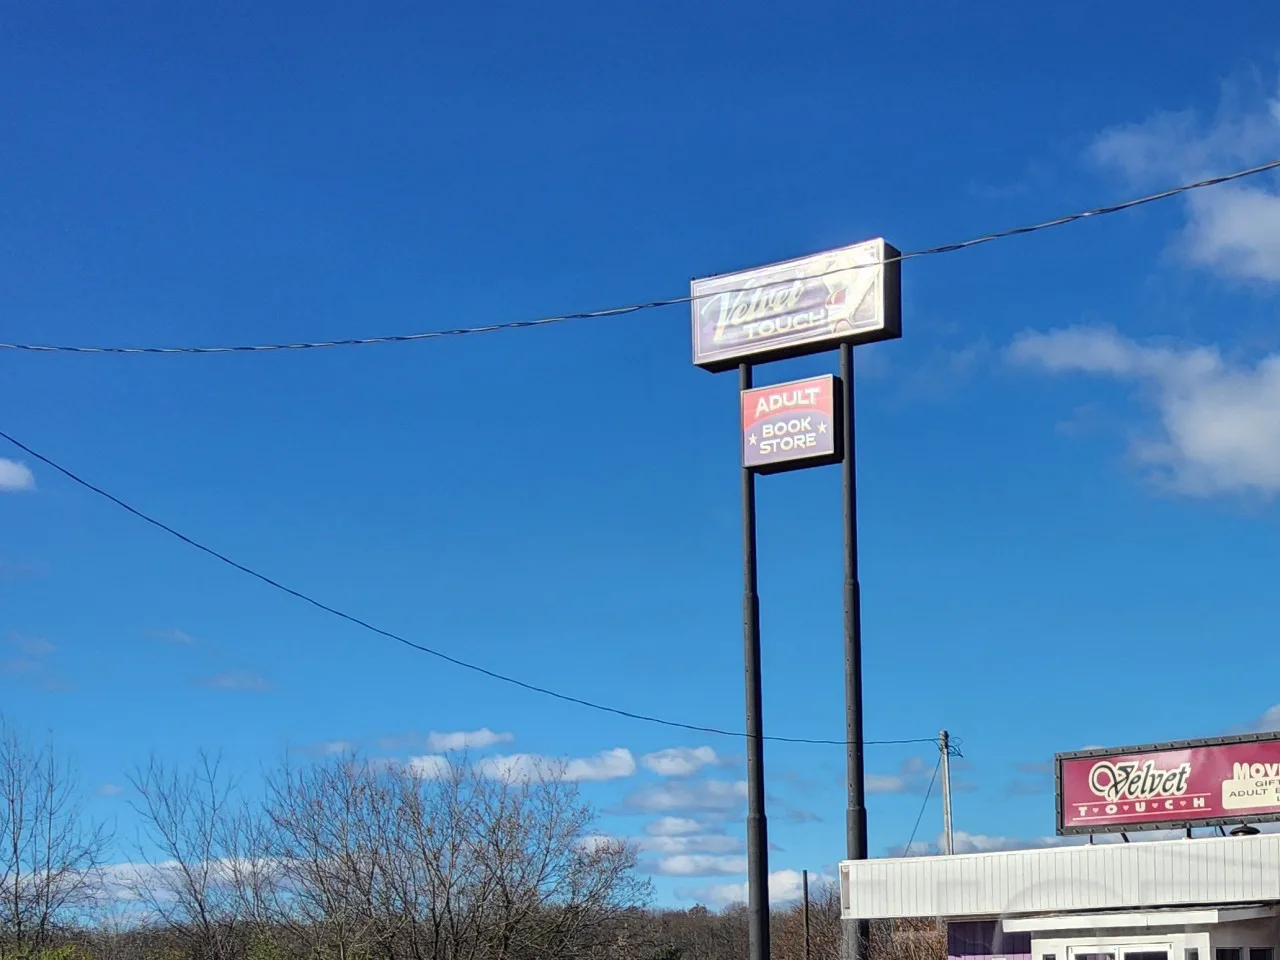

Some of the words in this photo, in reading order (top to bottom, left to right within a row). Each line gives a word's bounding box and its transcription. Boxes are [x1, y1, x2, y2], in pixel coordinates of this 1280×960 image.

[701, 278, 805, 344] Velvet
[743, 309, 827, 340] TOUCH
[755, 388, 820, 419] ADULT
[762, 416, 811, 438] BOOK
[760, 433, 816, 454] STORE
[1090, 761, 1190, 801] Velvet
[1229, 788, 1268, 798] ADULT
